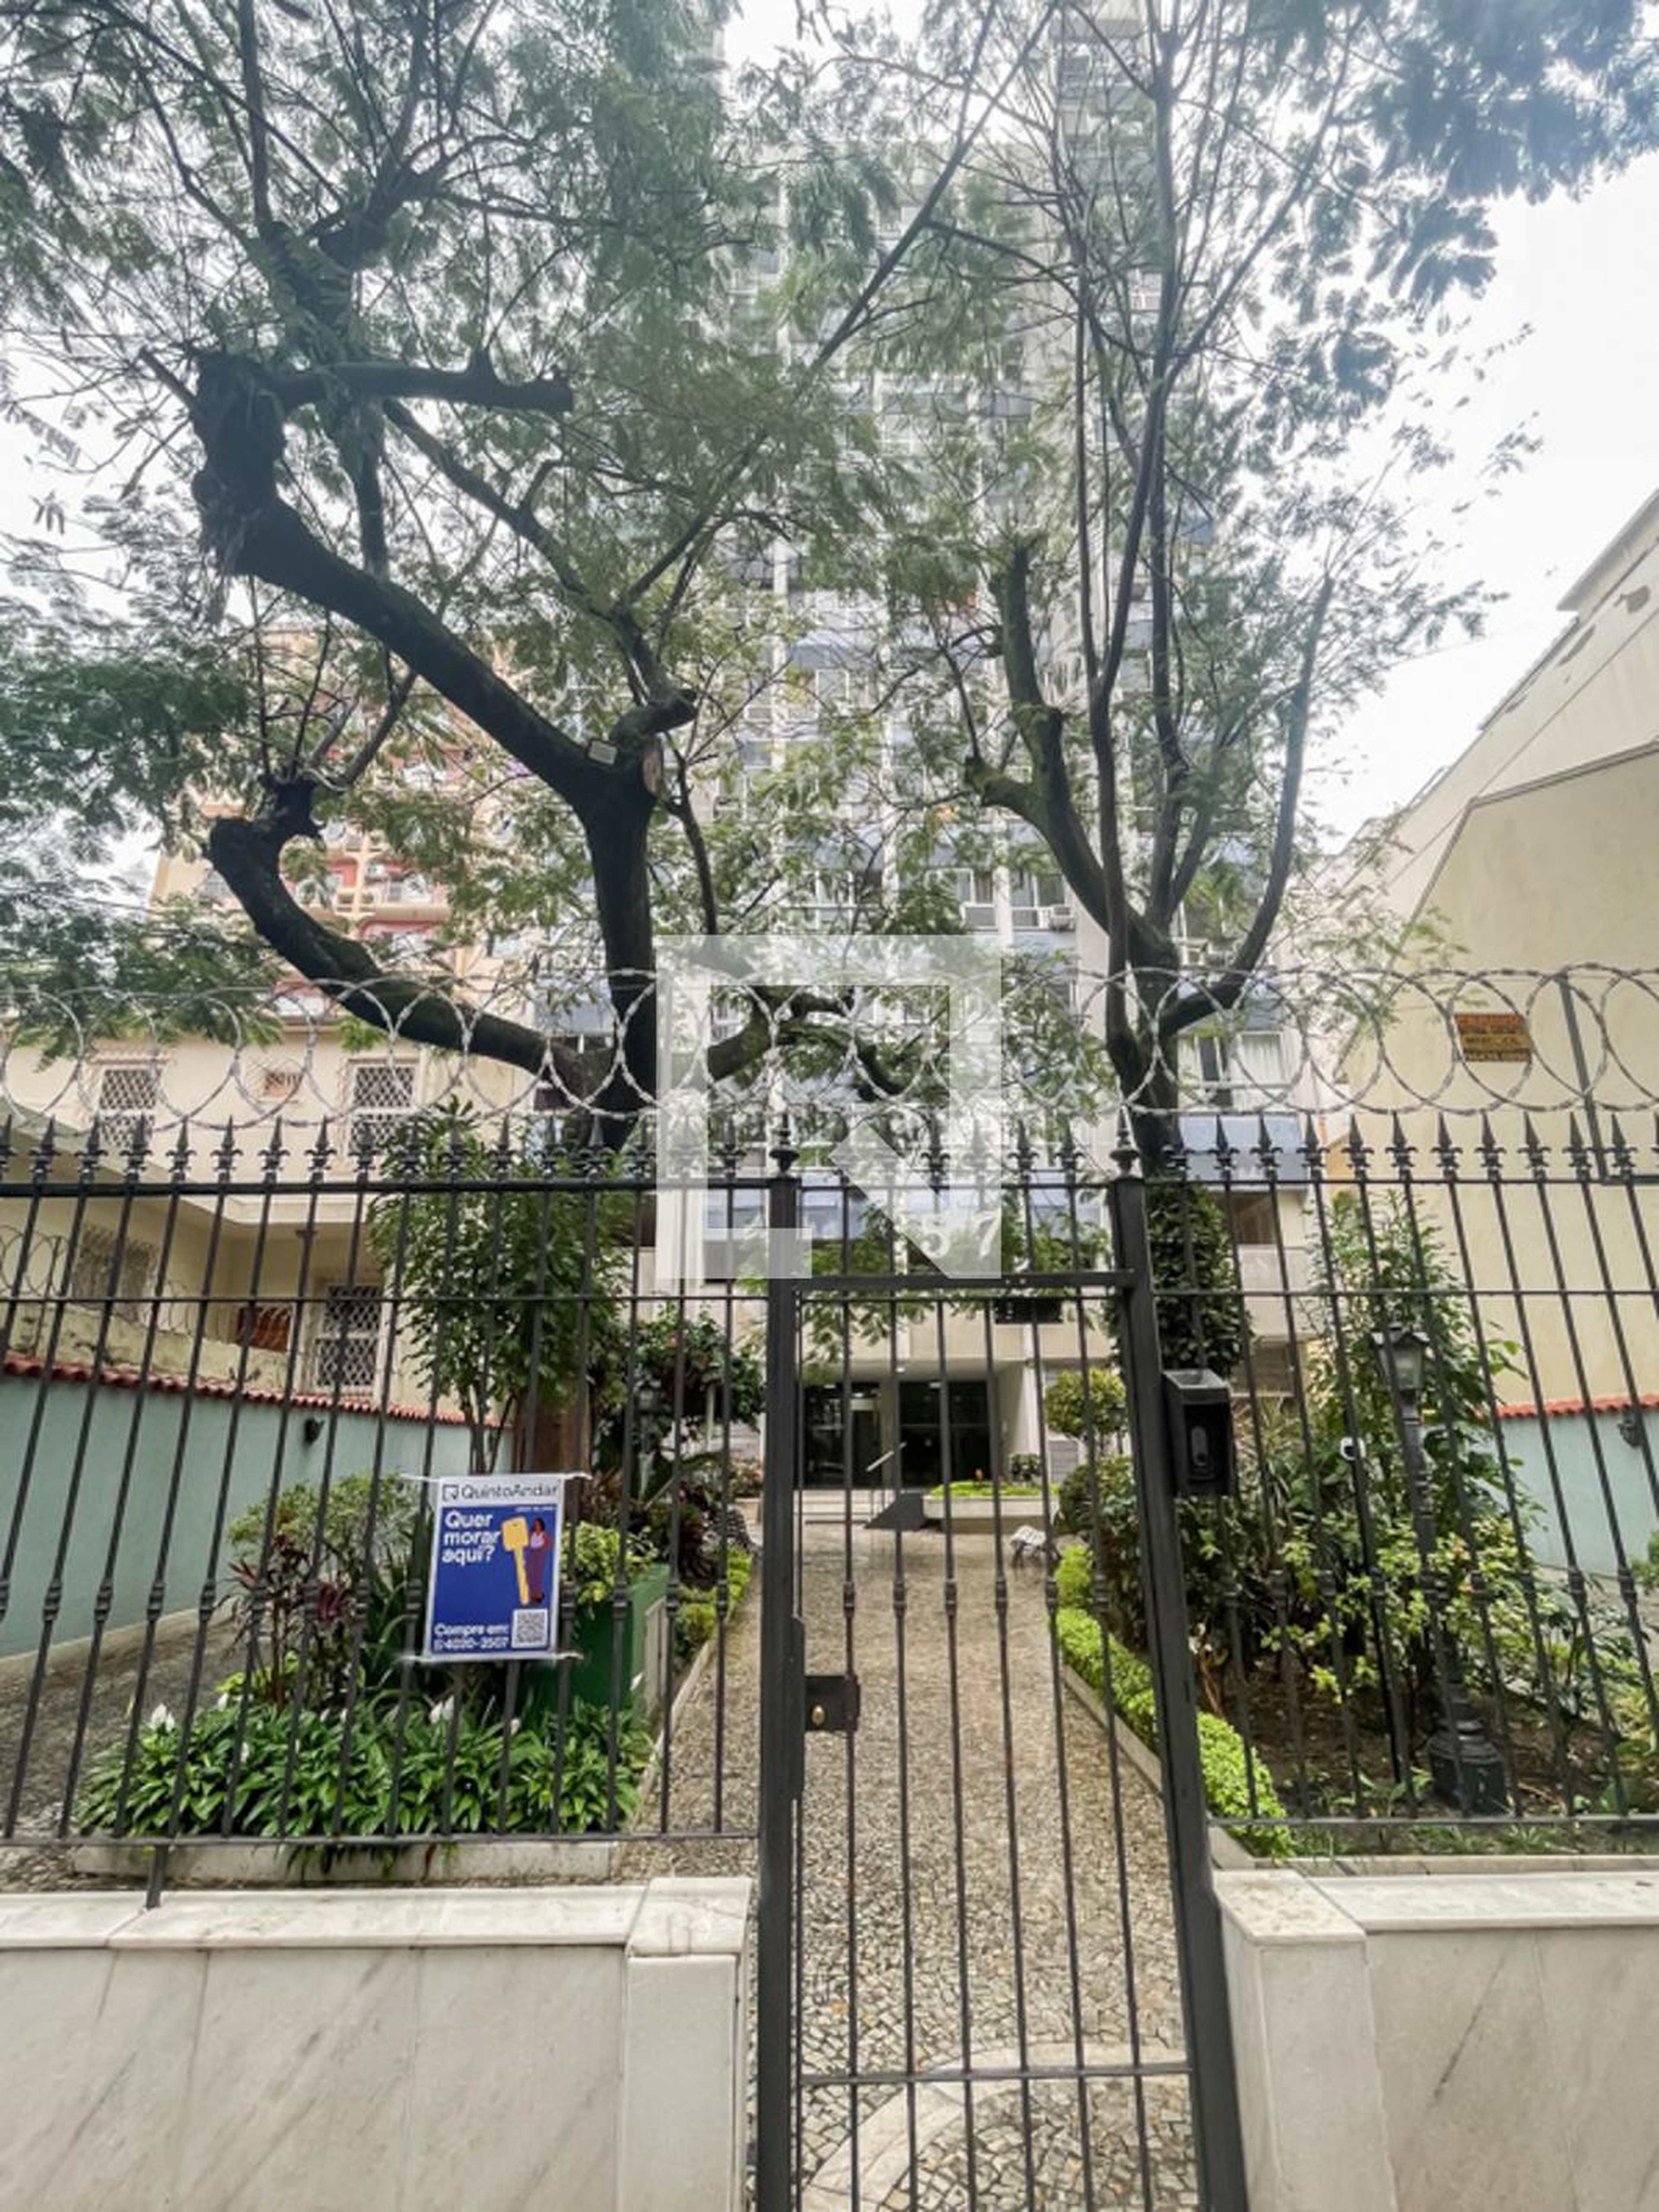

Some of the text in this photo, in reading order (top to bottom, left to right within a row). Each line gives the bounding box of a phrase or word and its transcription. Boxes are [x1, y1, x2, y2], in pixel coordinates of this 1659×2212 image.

[462, 1483, 558, 1500] QuintoAndar
[445, 1511, 493, 1528] Quer
[444, 1531, 501, 1545] morar
[442, 1546, 495, 1566] aqui?
